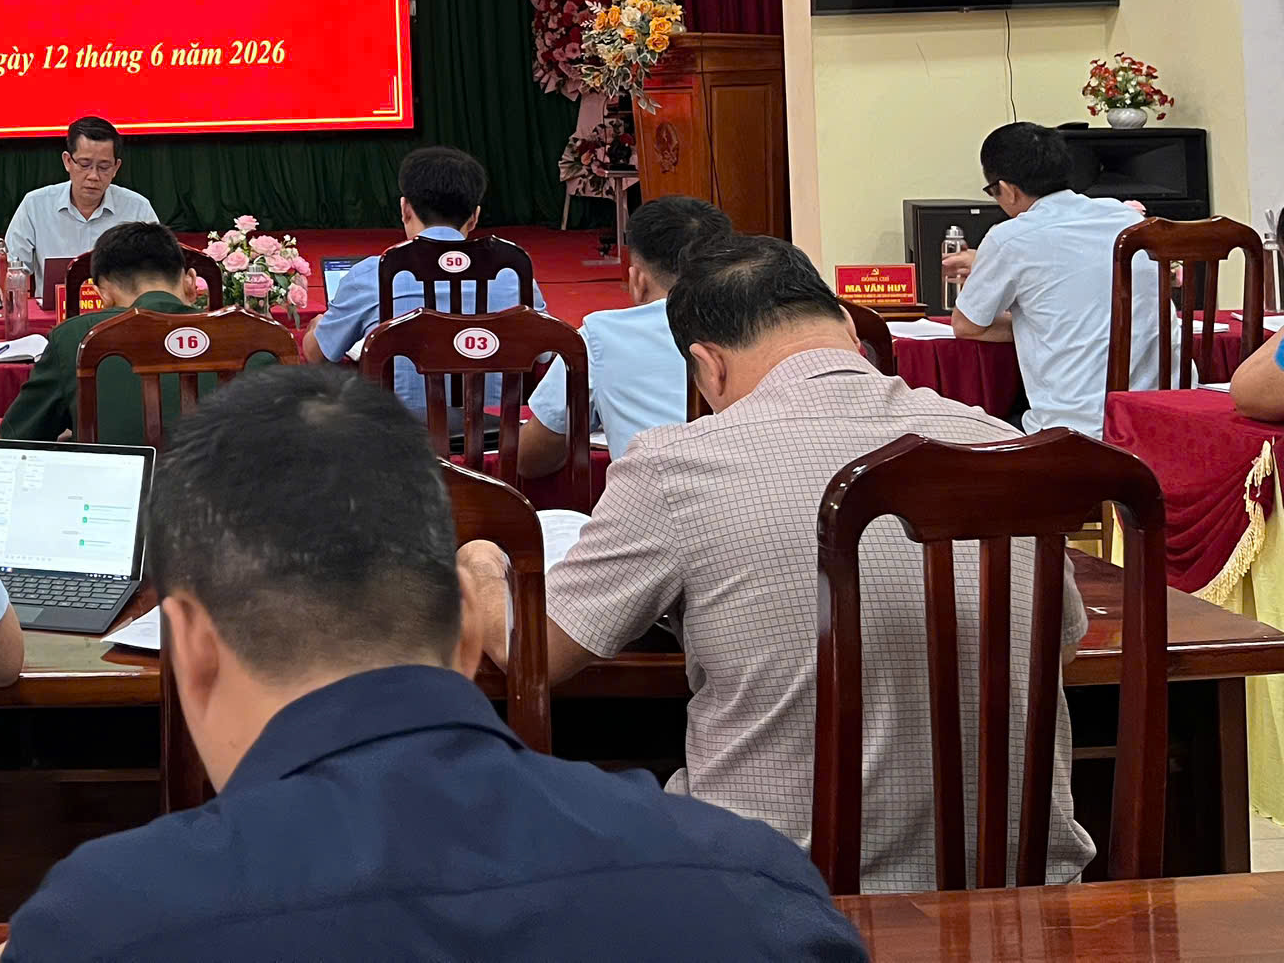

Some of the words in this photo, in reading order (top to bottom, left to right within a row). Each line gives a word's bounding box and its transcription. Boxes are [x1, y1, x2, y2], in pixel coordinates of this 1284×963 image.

[43, 44, 69, 69] 12
[75, 43, 144, 74] tháng
[150, 42, 164, 67] 6
[170, 42, 222, 66] năm
[229, 39, 285, 65] 2026
[446, 257, 462, 266] 50
[845, 284, 862, 293] MA
[864, 283, 885, 293] VĂN
[888, 284, 907, 293] HUY
[176, 336, 198, 349] 16
[465, 336, 488, 350] 03
